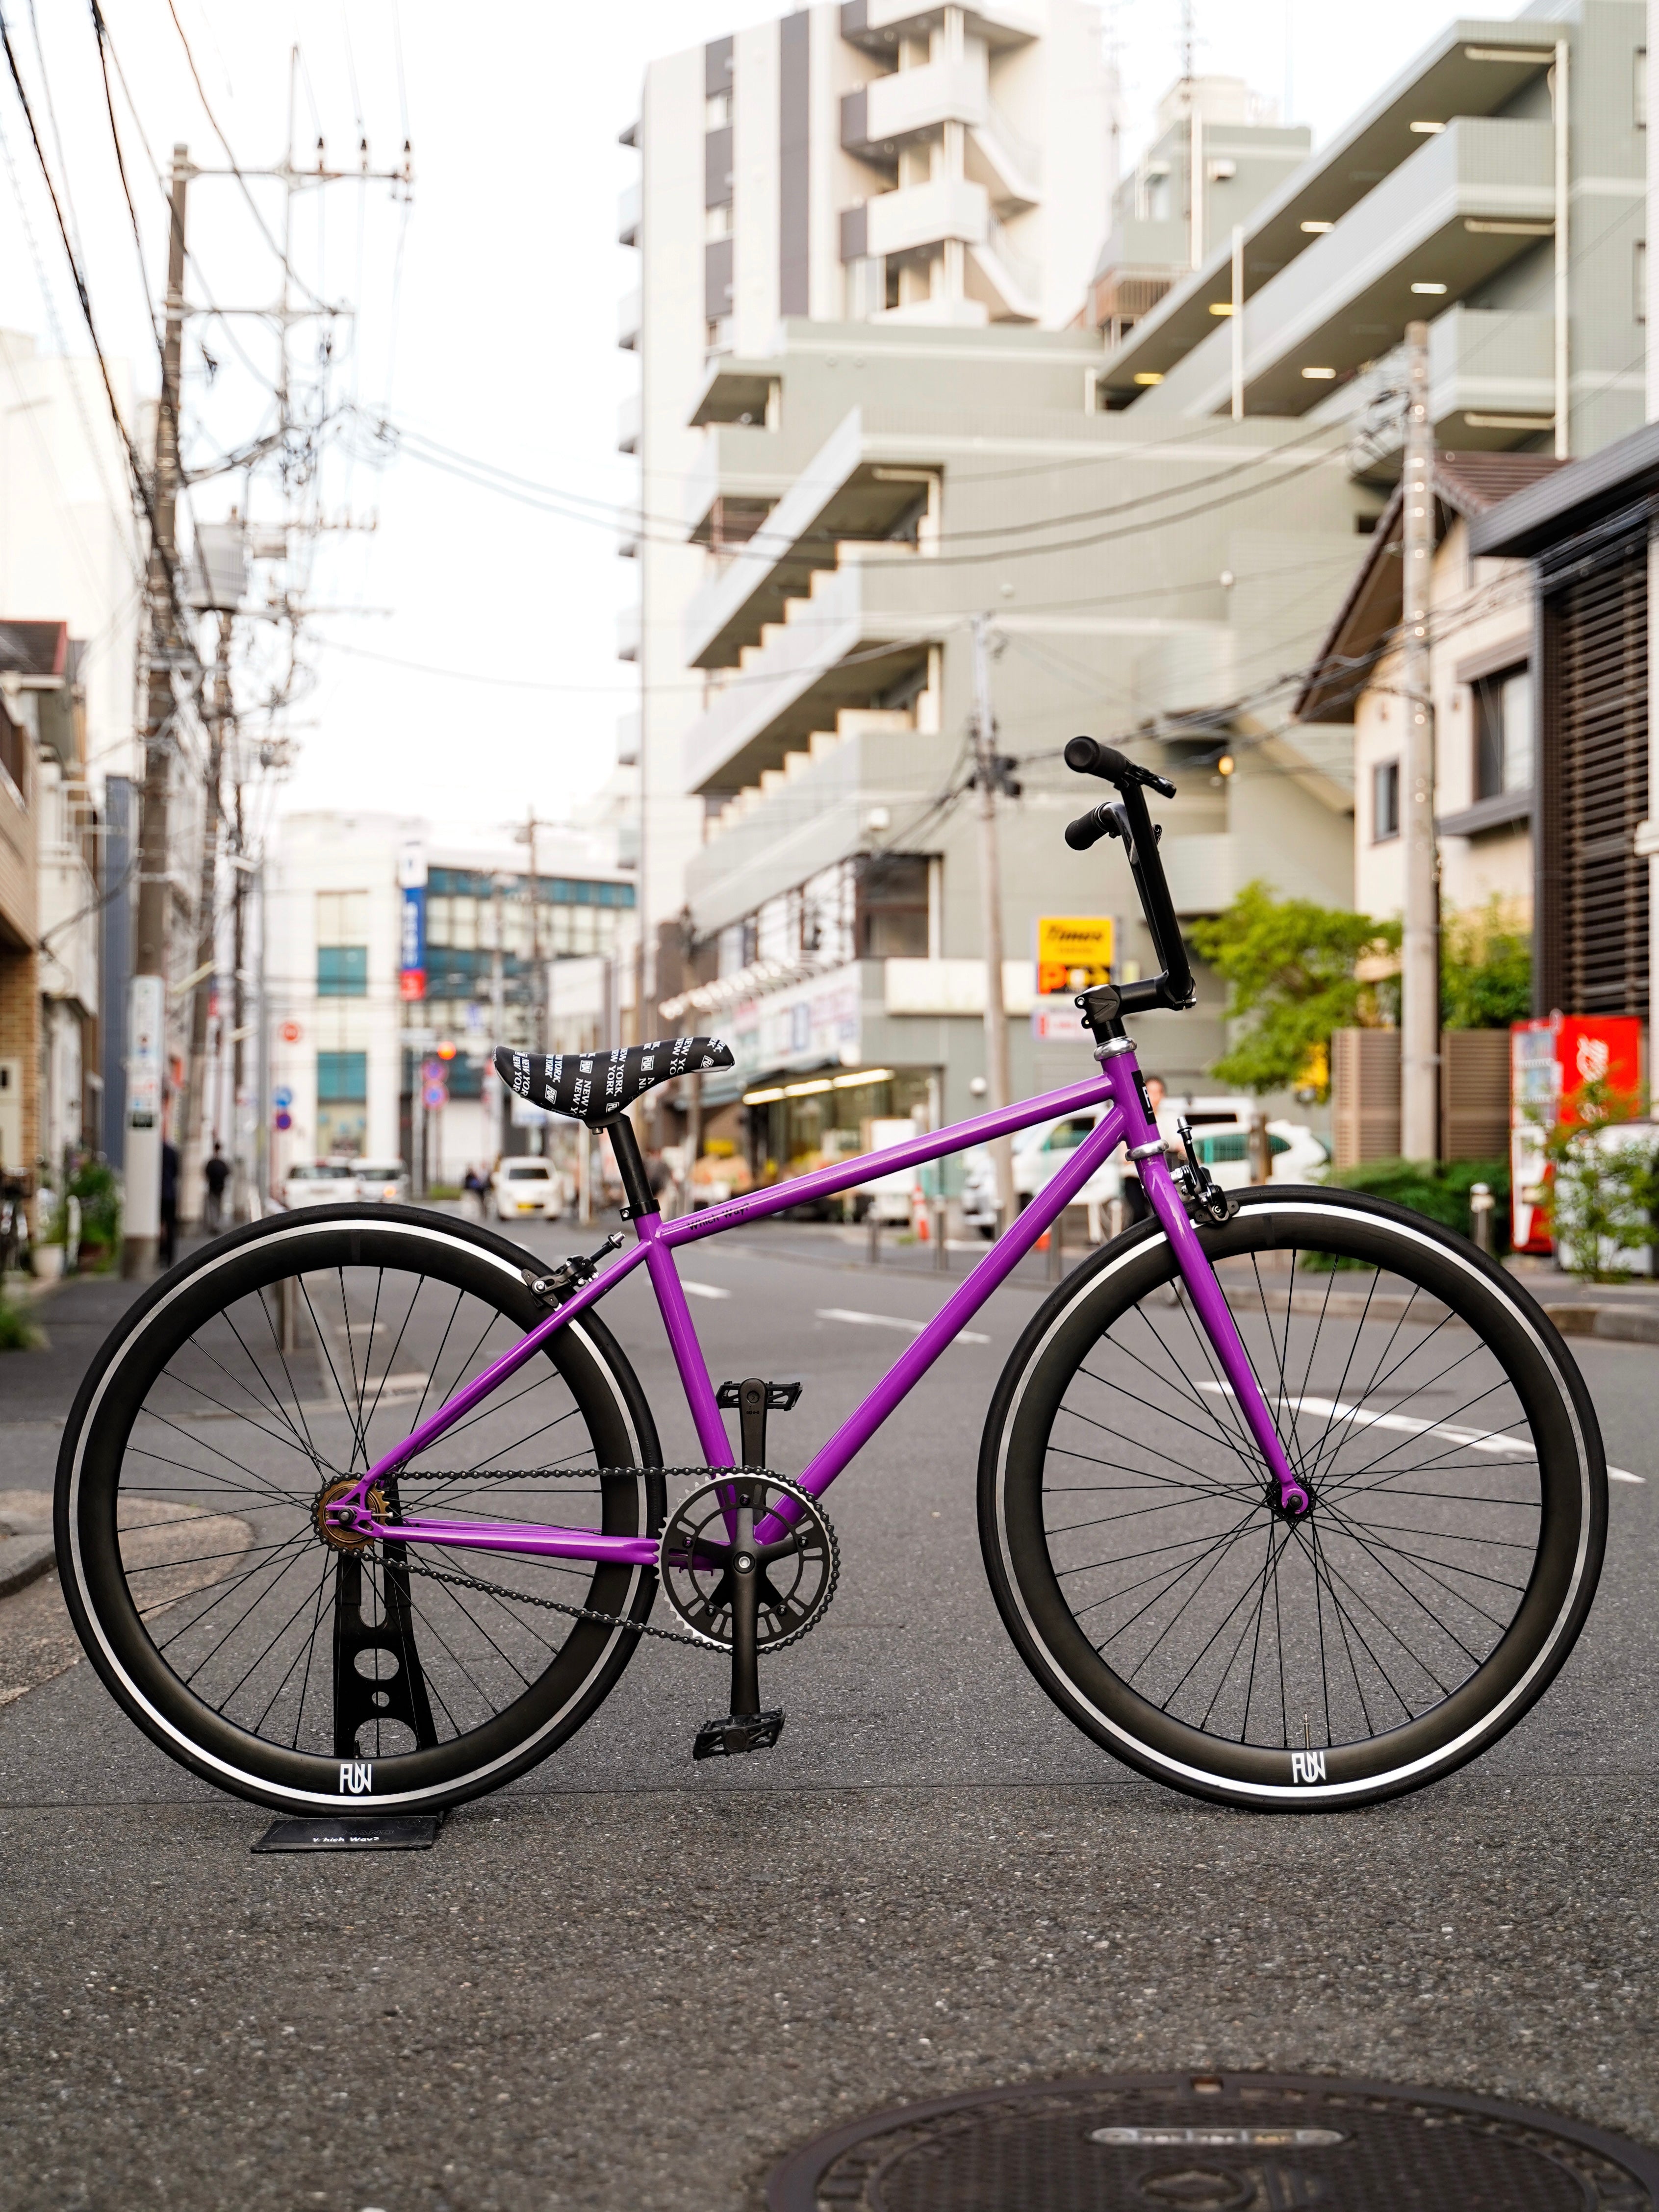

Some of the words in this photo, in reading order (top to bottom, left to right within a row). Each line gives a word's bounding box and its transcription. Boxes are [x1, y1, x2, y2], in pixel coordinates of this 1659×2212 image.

[573, 1077, 584, 1105] NEW
[581, 1079, 592, 1107] NEW
[606, 1065, 616, 1095] YORK
[688, 1214, 719, 1230] Which
